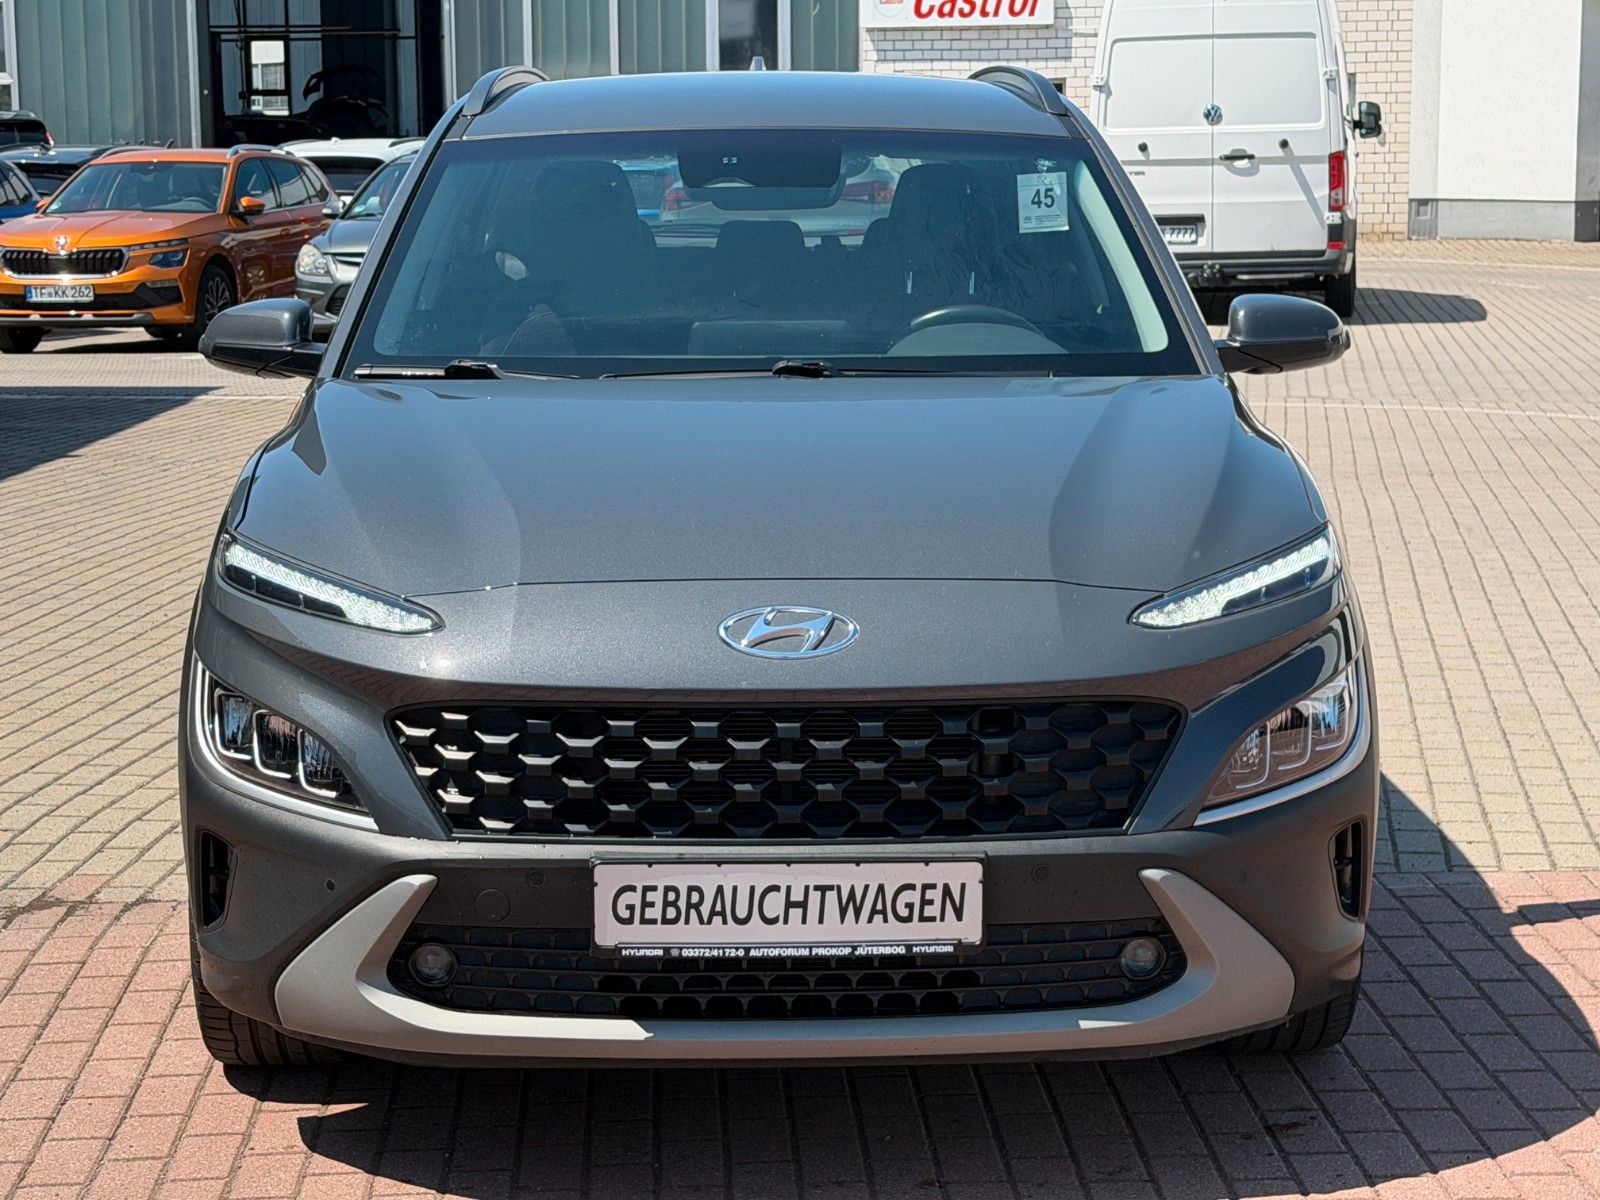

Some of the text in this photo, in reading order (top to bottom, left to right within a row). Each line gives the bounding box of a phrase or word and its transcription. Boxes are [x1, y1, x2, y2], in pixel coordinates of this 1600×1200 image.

[1031, 188, 1055, 209] 45
[71, 286, 92, 298] 262
[611, 882, 966, 926] GEBRAUCHTWAGEN
[749, 947, 809, 957] AUTOFORUM
[811, 947, 852, 956] PROKOP
[854, 944, 906, 955] JÜTERBOG
[912, 945, 954, 953] HYUNDAI
